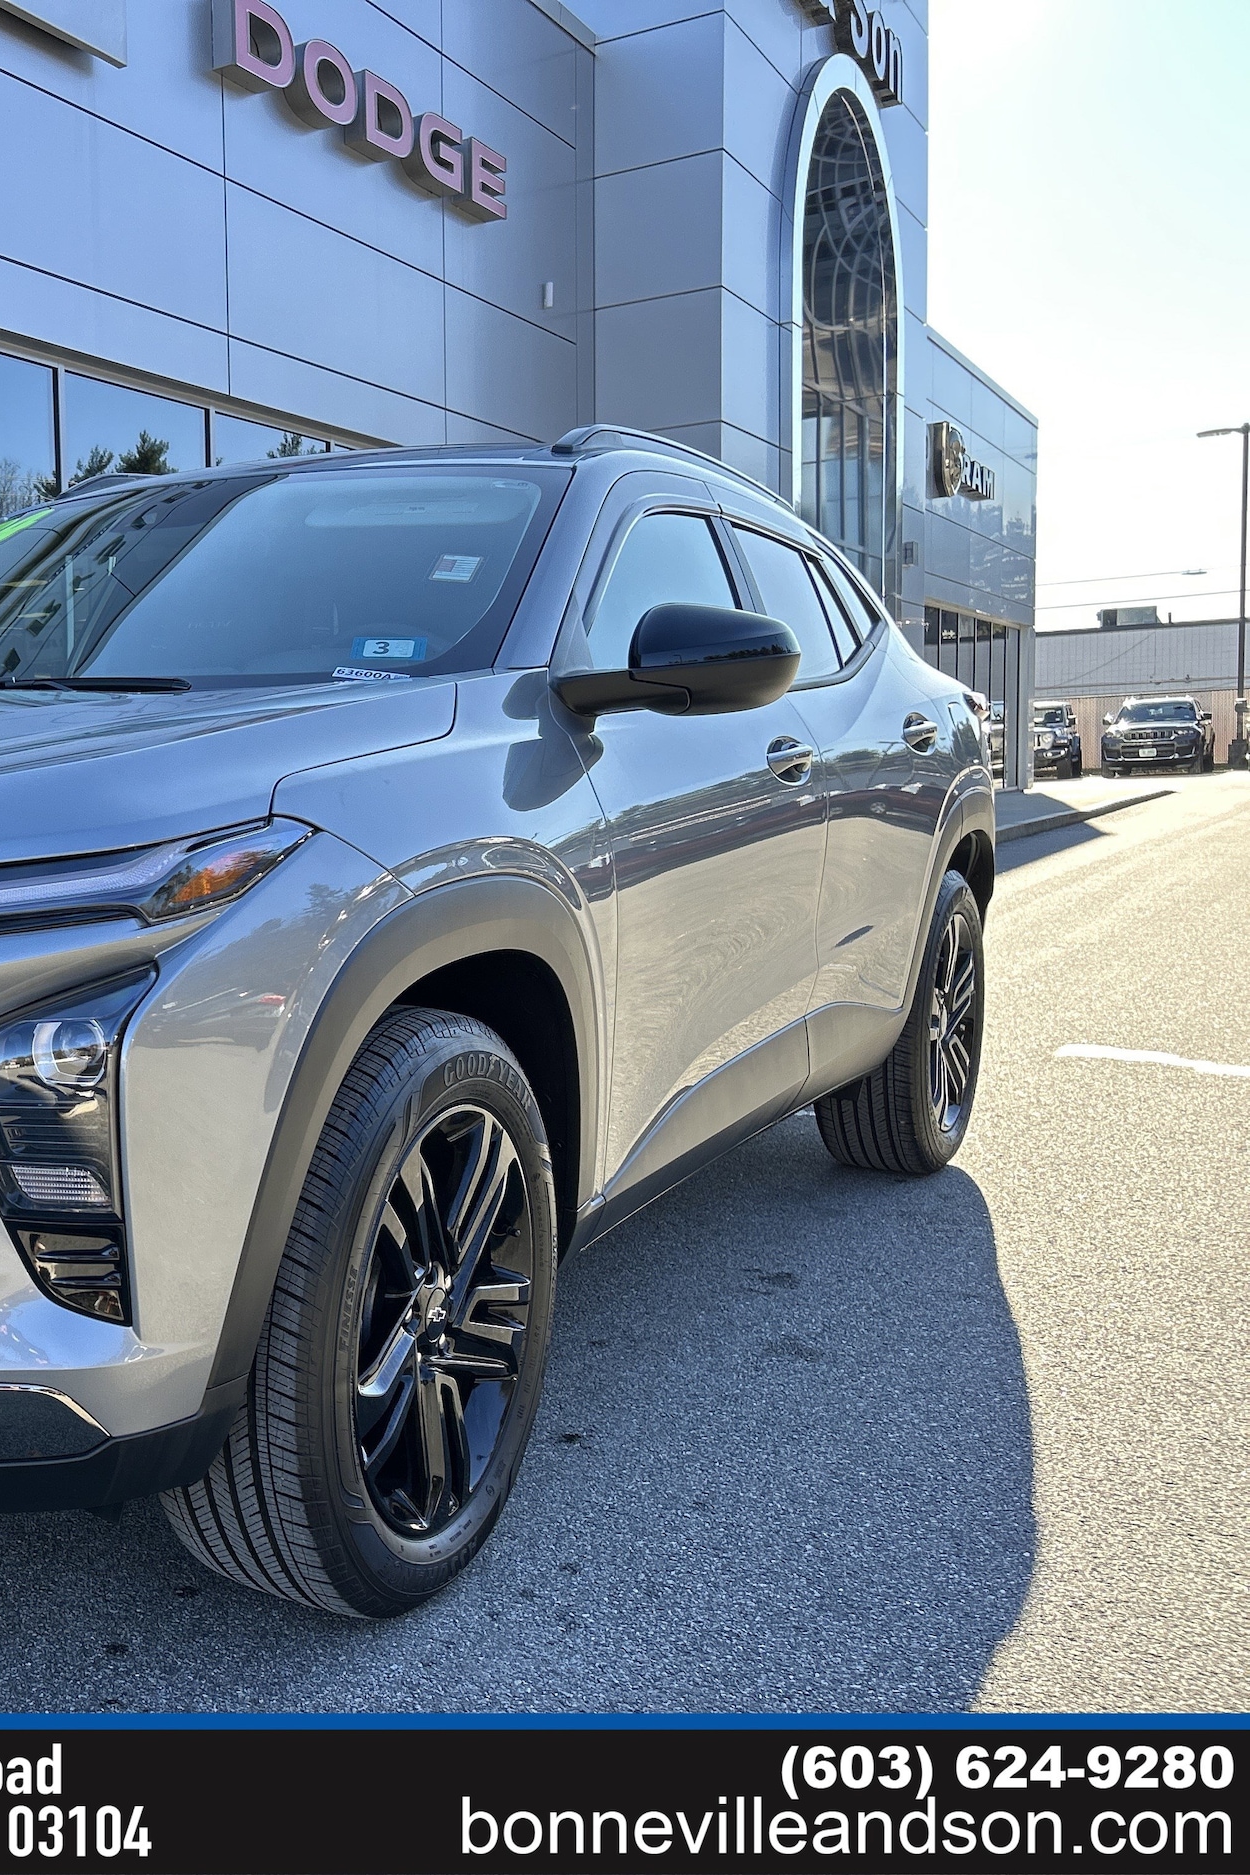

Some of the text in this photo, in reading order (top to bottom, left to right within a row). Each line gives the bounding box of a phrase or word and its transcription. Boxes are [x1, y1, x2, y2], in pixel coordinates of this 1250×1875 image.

[234, 0, 507, 220] DODGE
[960, 453, 995, 500] RAM
[372, 641, 390, 655] 3
[336, 668, 392, 680] 63600A
[443, 1053, 531, 1113] GOODYEAR
